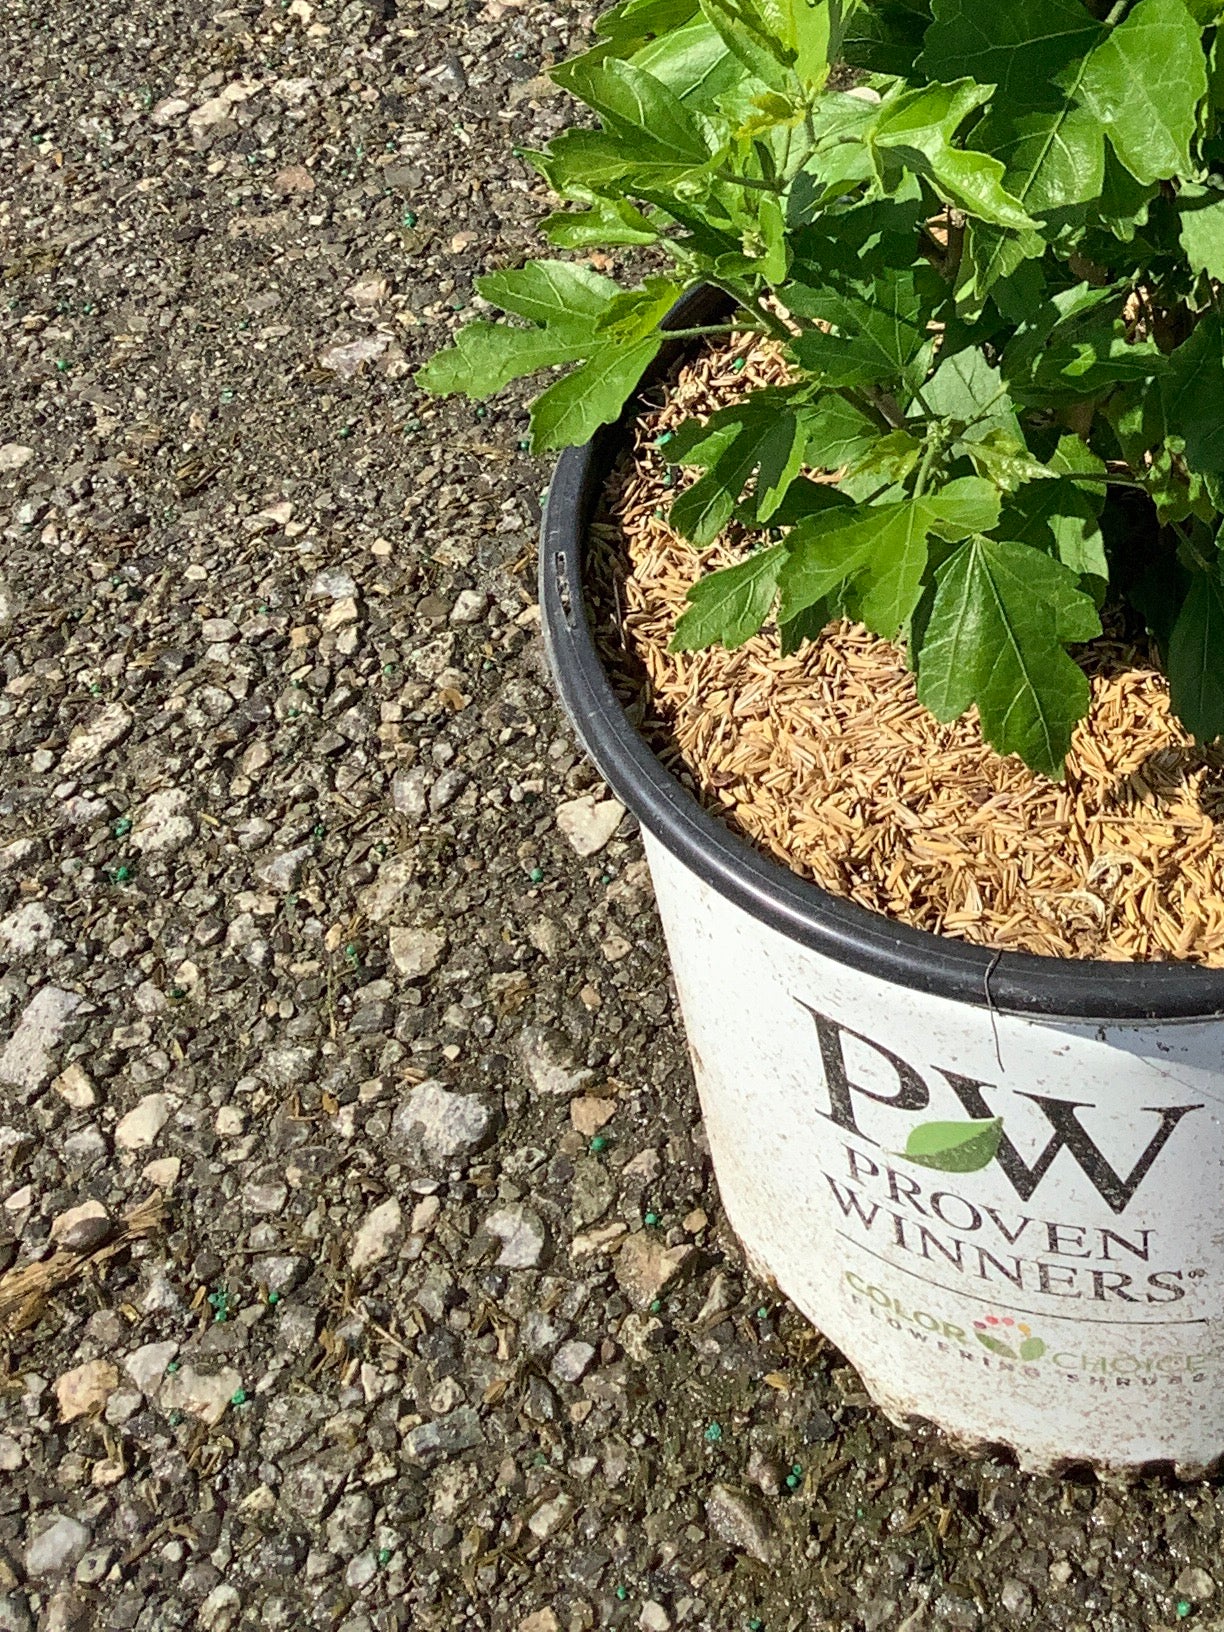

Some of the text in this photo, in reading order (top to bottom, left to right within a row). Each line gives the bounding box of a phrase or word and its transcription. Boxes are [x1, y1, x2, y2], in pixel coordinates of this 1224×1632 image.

[793, 996, 1205, 1215] PW
[840, 1144, 1156, 1262] PROVEN
[844, 1270, 1207, 1375] COLOR CHOICE
[851, 1293, 1207, 1390] FLOWERING SHRUBS
